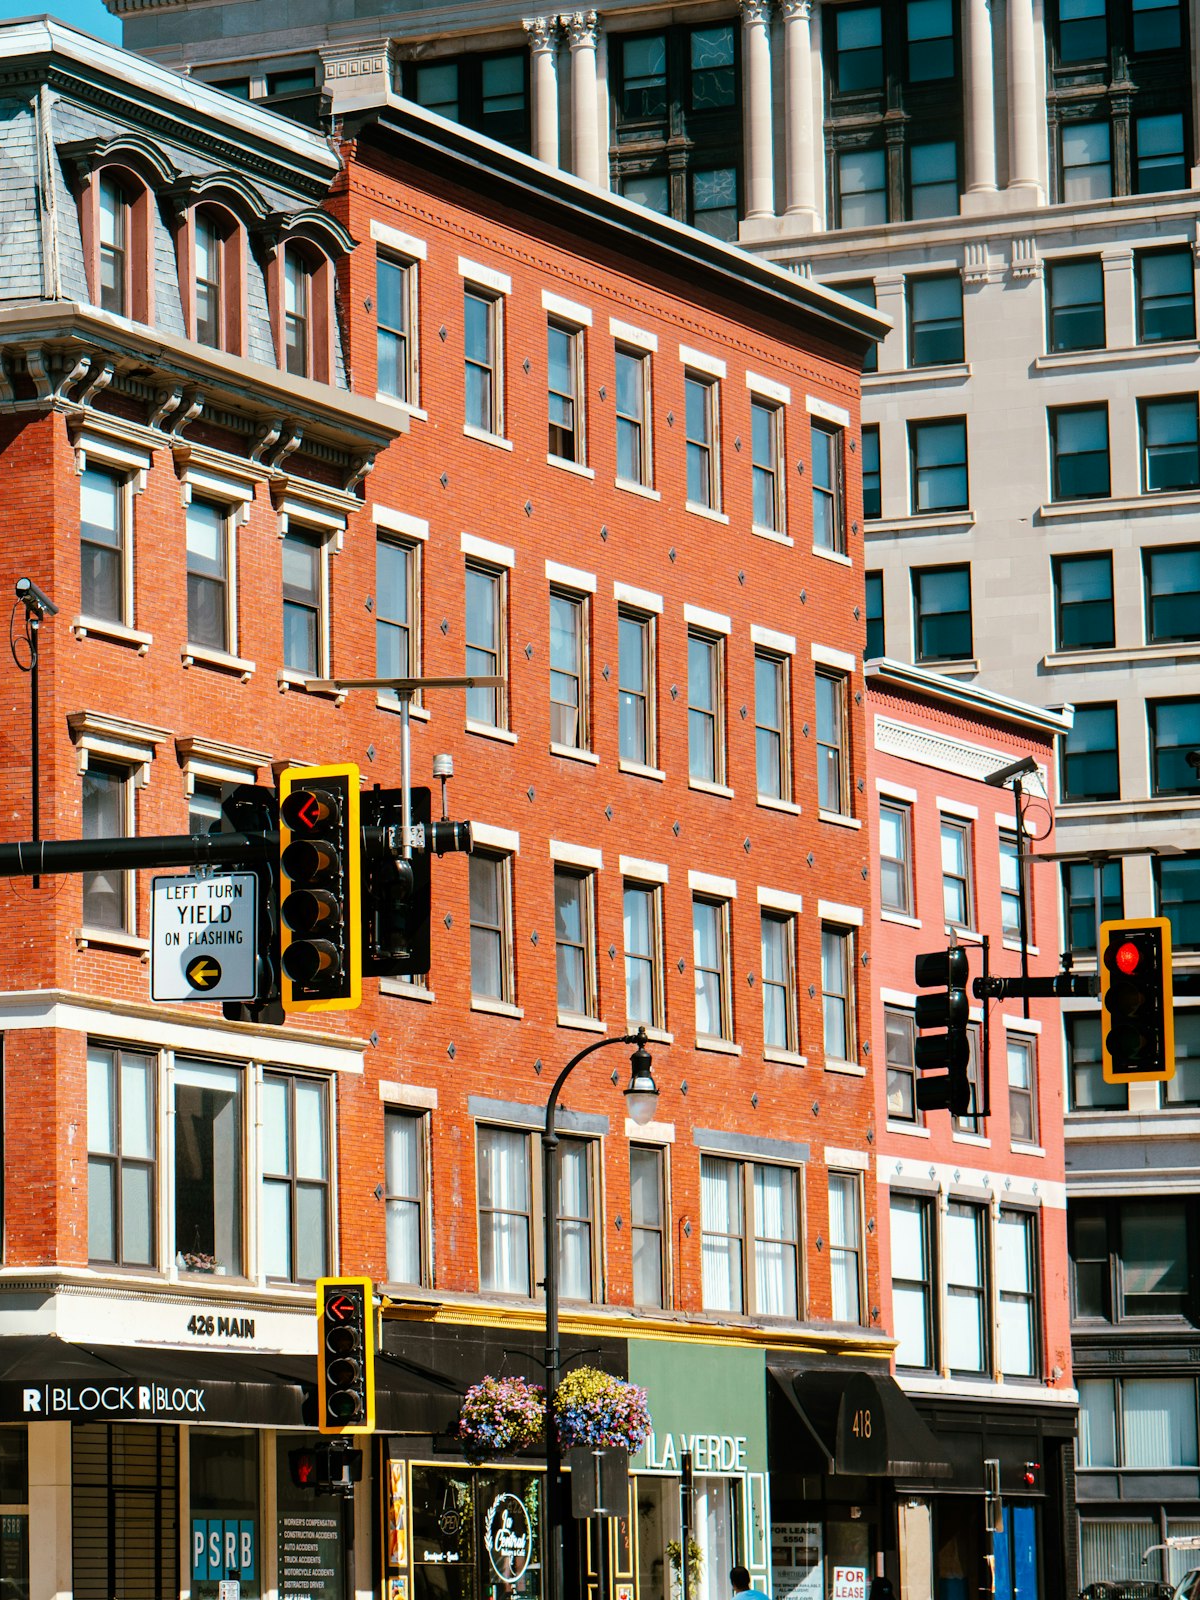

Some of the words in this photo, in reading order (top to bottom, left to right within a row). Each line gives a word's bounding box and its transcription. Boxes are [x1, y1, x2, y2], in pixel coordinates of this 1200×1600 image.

[166, 886, 198, 900] LEFT
[207, 884, 243, 898] TURN
[177, 905, 232, 924] YIELD
[165, 932, 180, 945] ON
[188, 930, 243, 945] FLASHING
[187, 1315, 214, 1336] 426
[218, 1317, 256, 1338] MAIN
[852, 1409, 872, 1438] 418
[680, 1434, 748, 1471] VERDE
[2, 1518, 21, 1534] PSRB
[194, 1532, 252, 1568] PSRB
[284, 1543, 296, 1551] AUTO
[296, 1544, 319, 1552] ACCIDENTS
[836, 1570, 864, 1582] FOR
[835, 1587, 864, 1599] LEASE
